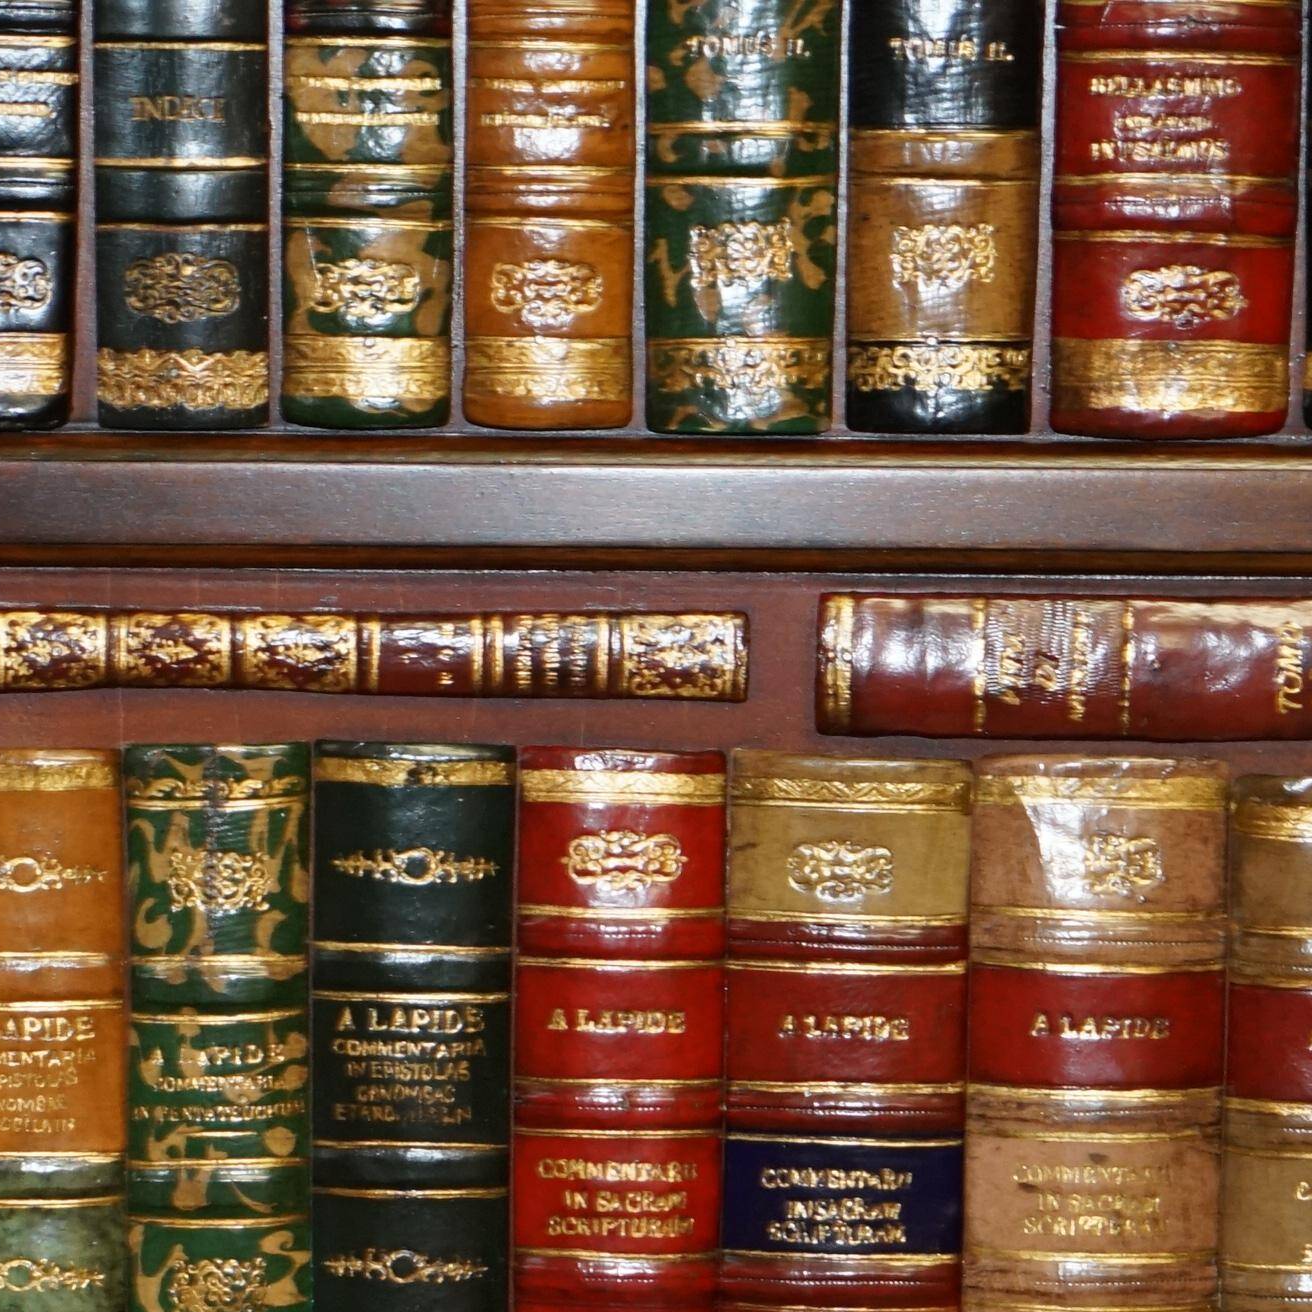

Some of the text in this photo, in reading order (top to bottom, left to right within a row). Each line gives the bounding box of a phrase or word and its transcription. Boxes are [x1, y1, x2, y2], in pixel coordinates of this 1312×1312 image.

[1274, 621, 1304, 715] TOMO
[335, 1006, 486, 1034] A LAPIDE
[547, 1009, 687, 1035] A LAPIDE
[778, 1014, 911, 1041] A LAPIDE
[1030, 1012, 1172, 1041] A LAPIDE
[151, 1042, 286, 1067] A LAPIDE
[331, 1037, 487, 1059] COMMENTARIA
[564, 1190, 587, 1211] IN
